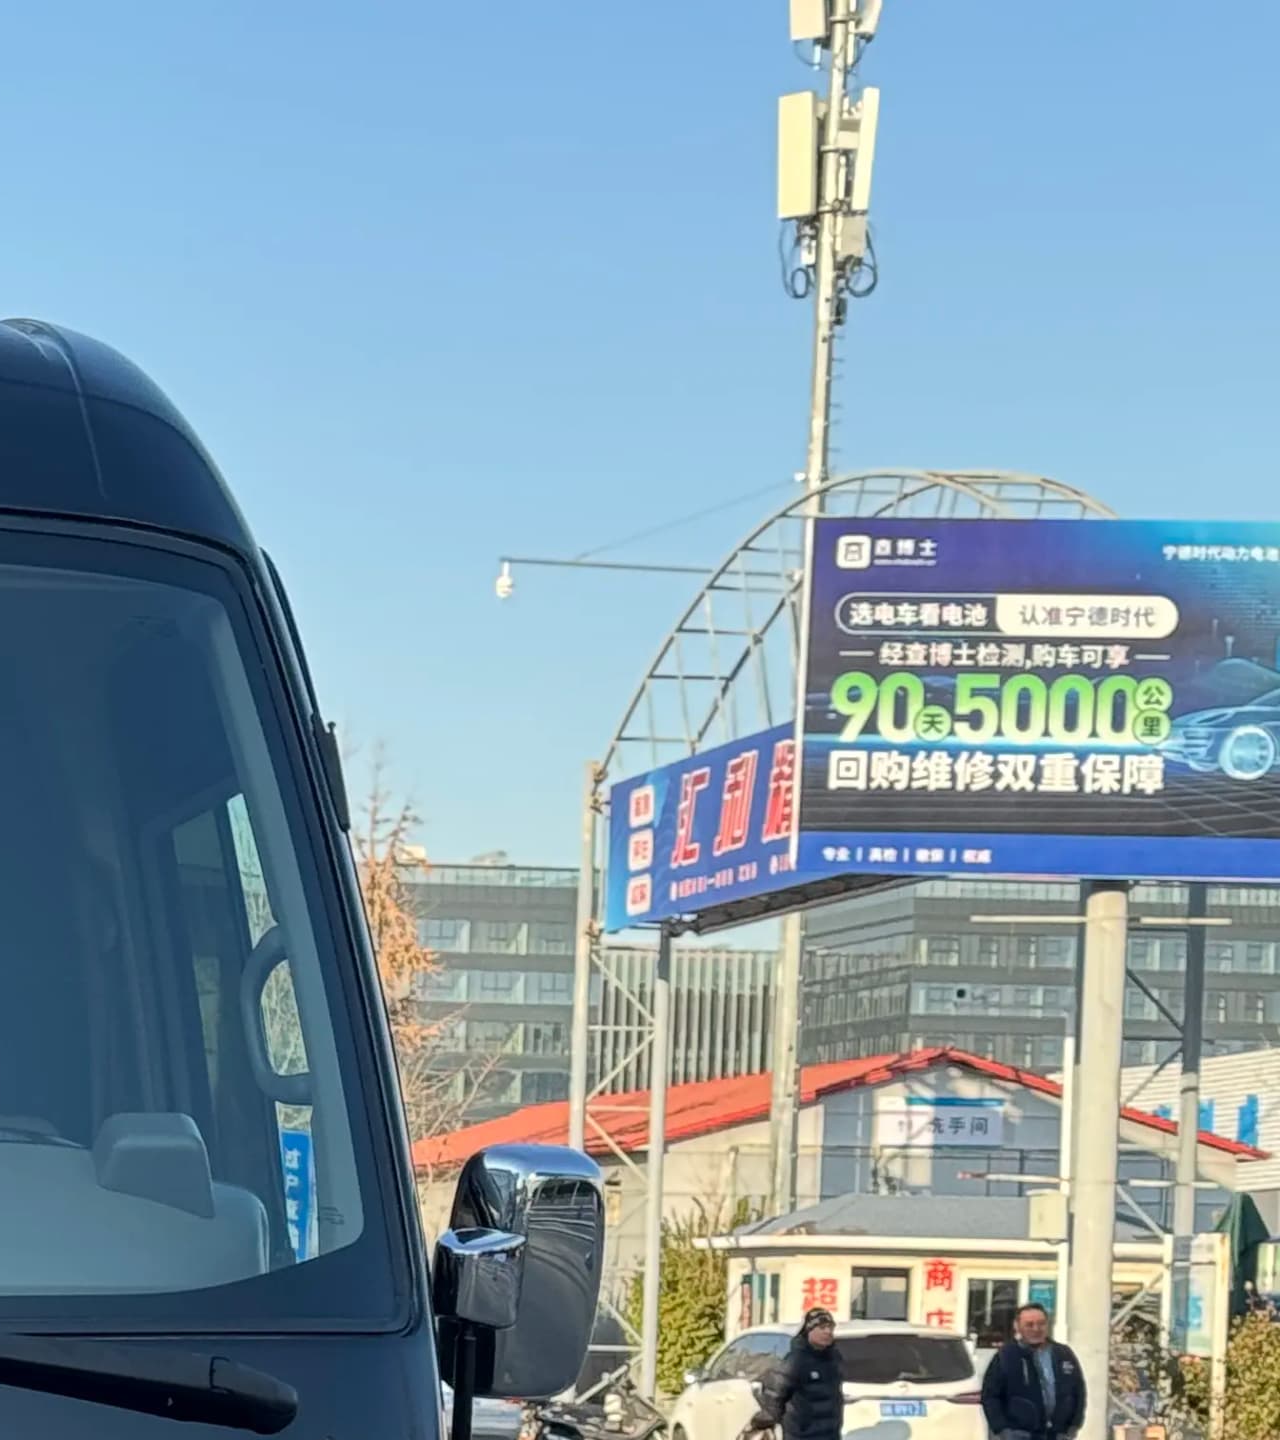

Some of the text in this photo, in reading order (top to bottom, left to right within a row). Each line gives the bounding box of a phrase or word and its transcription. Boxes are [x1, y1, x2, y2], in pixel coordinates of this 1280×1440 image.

[850, 602, 1156, 628] 选电车看电池 认准宁德时代
[827, 750, 1165, 794] 回购维修双重保障
[928, 1116, 989, 1136] 洗手间
[802, 1277, 839, 1312] 超
